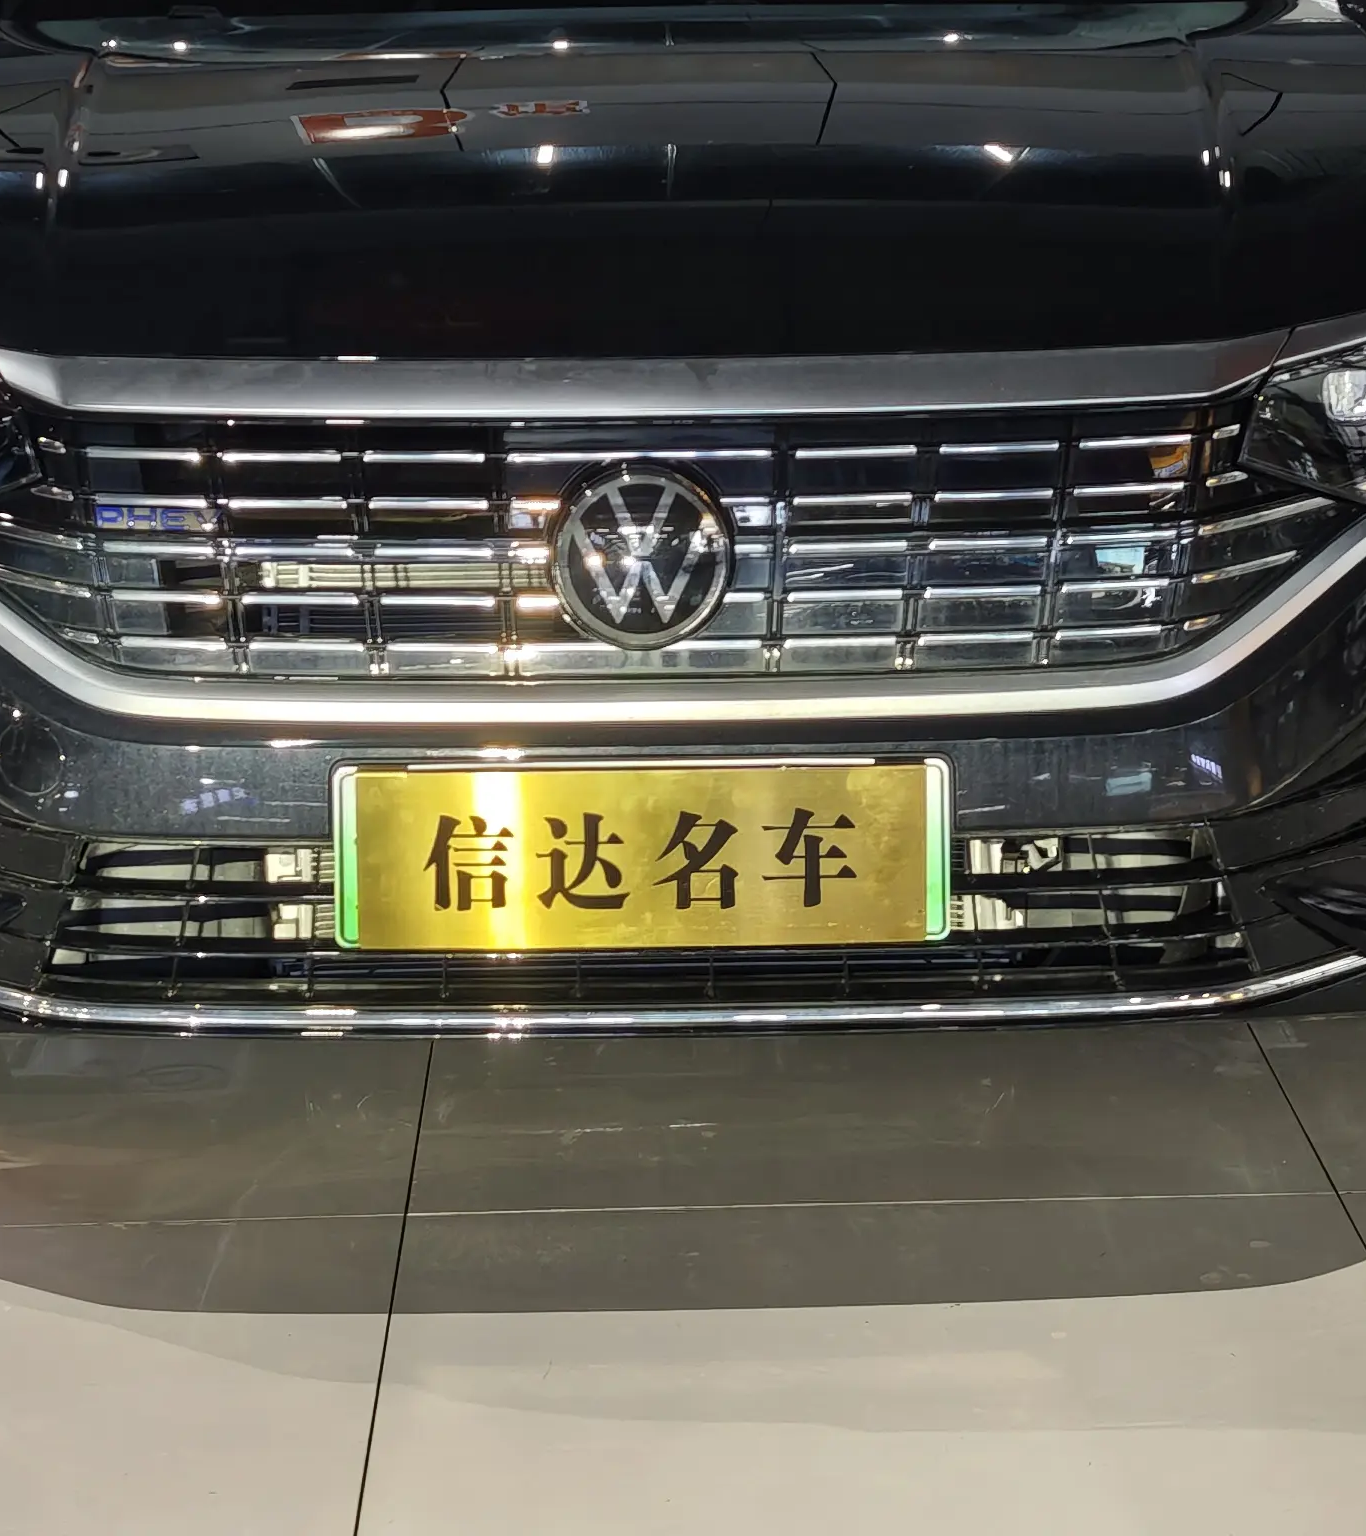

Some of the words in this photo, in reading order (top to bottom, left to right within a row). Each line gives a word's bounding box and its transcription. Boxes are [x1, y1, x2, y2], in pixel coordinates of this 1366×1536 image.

[95, 506, 222, 530] PHEV
[422, 806, 858, 912] 信达名车
